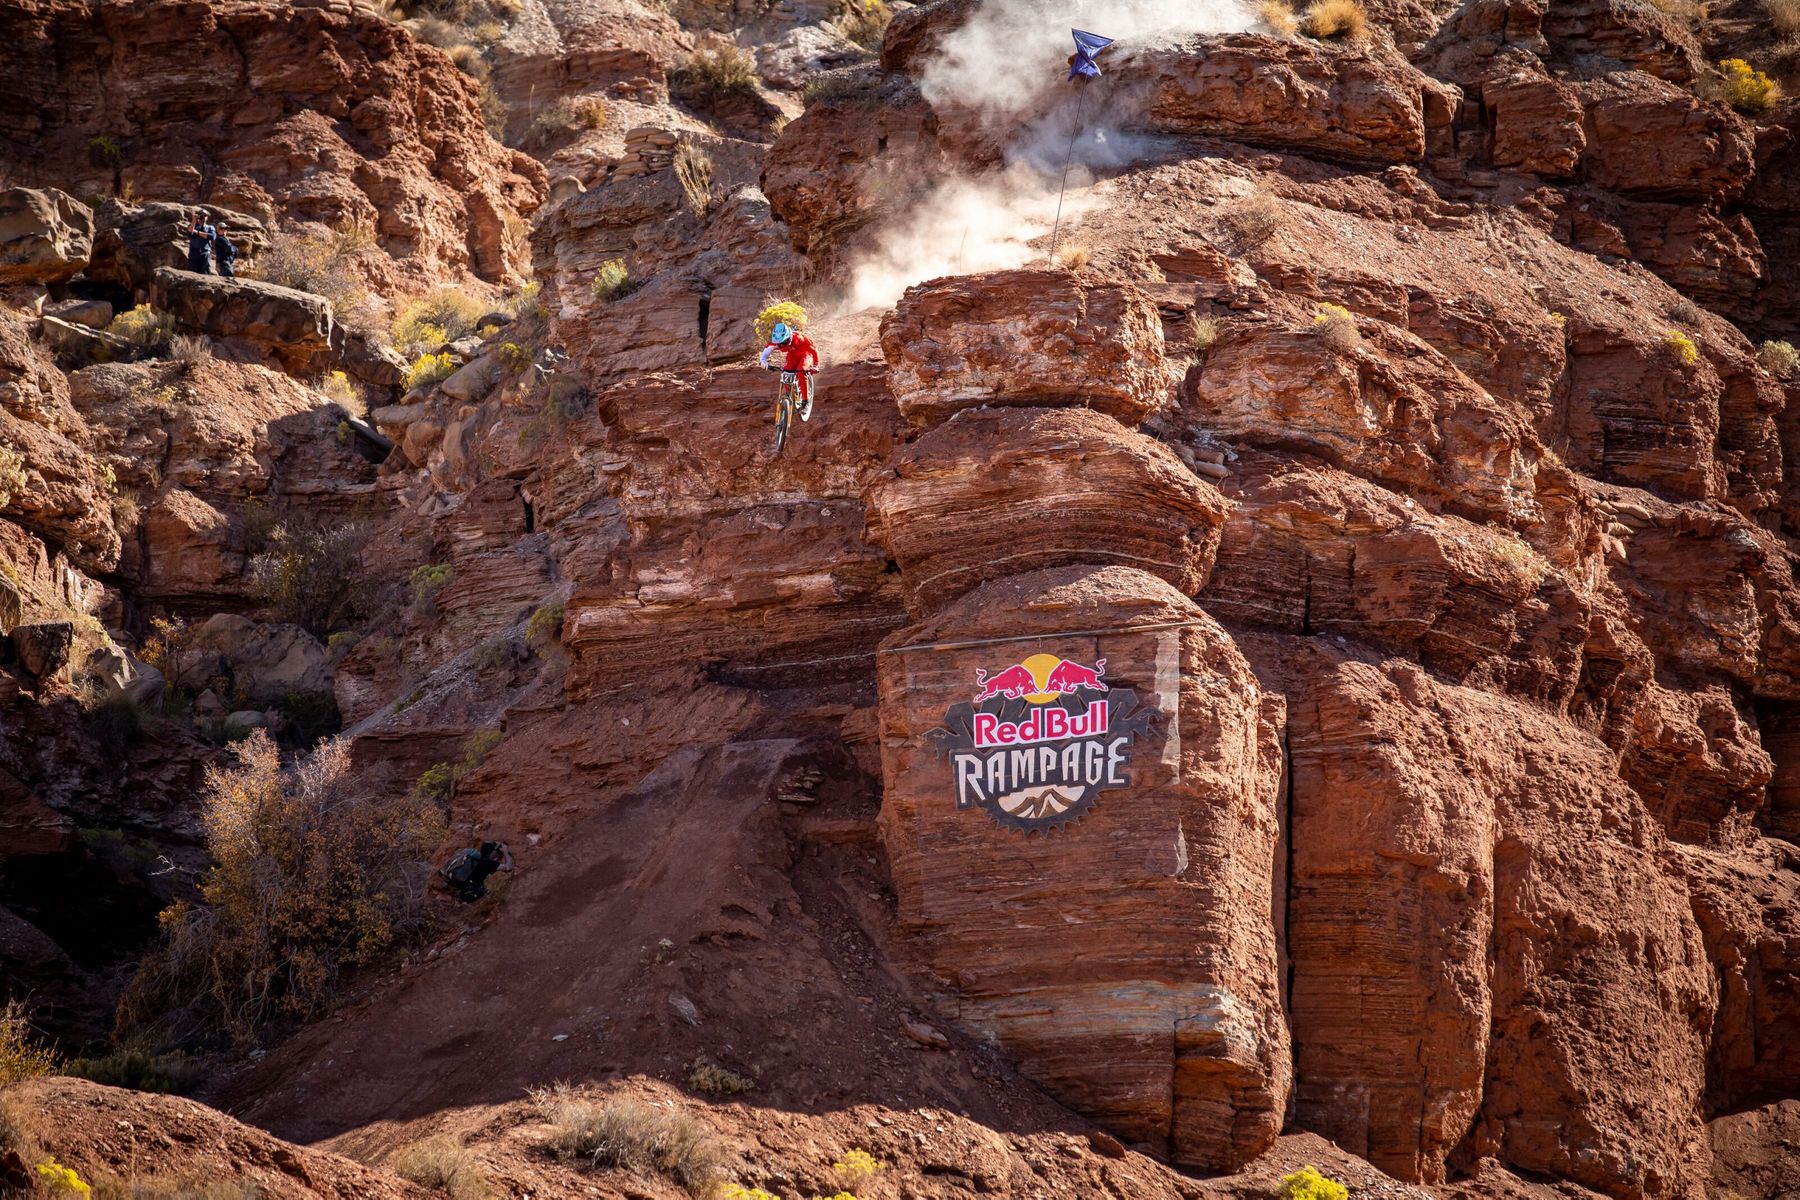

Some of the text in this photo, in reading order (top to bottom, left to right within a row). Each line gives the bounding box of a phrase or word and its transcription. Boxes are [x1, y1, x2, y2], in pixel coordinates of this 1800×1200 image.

[974, 701, 1107, 746] Red Bull
[954, 737, 1128, 804] RAMPAGE
